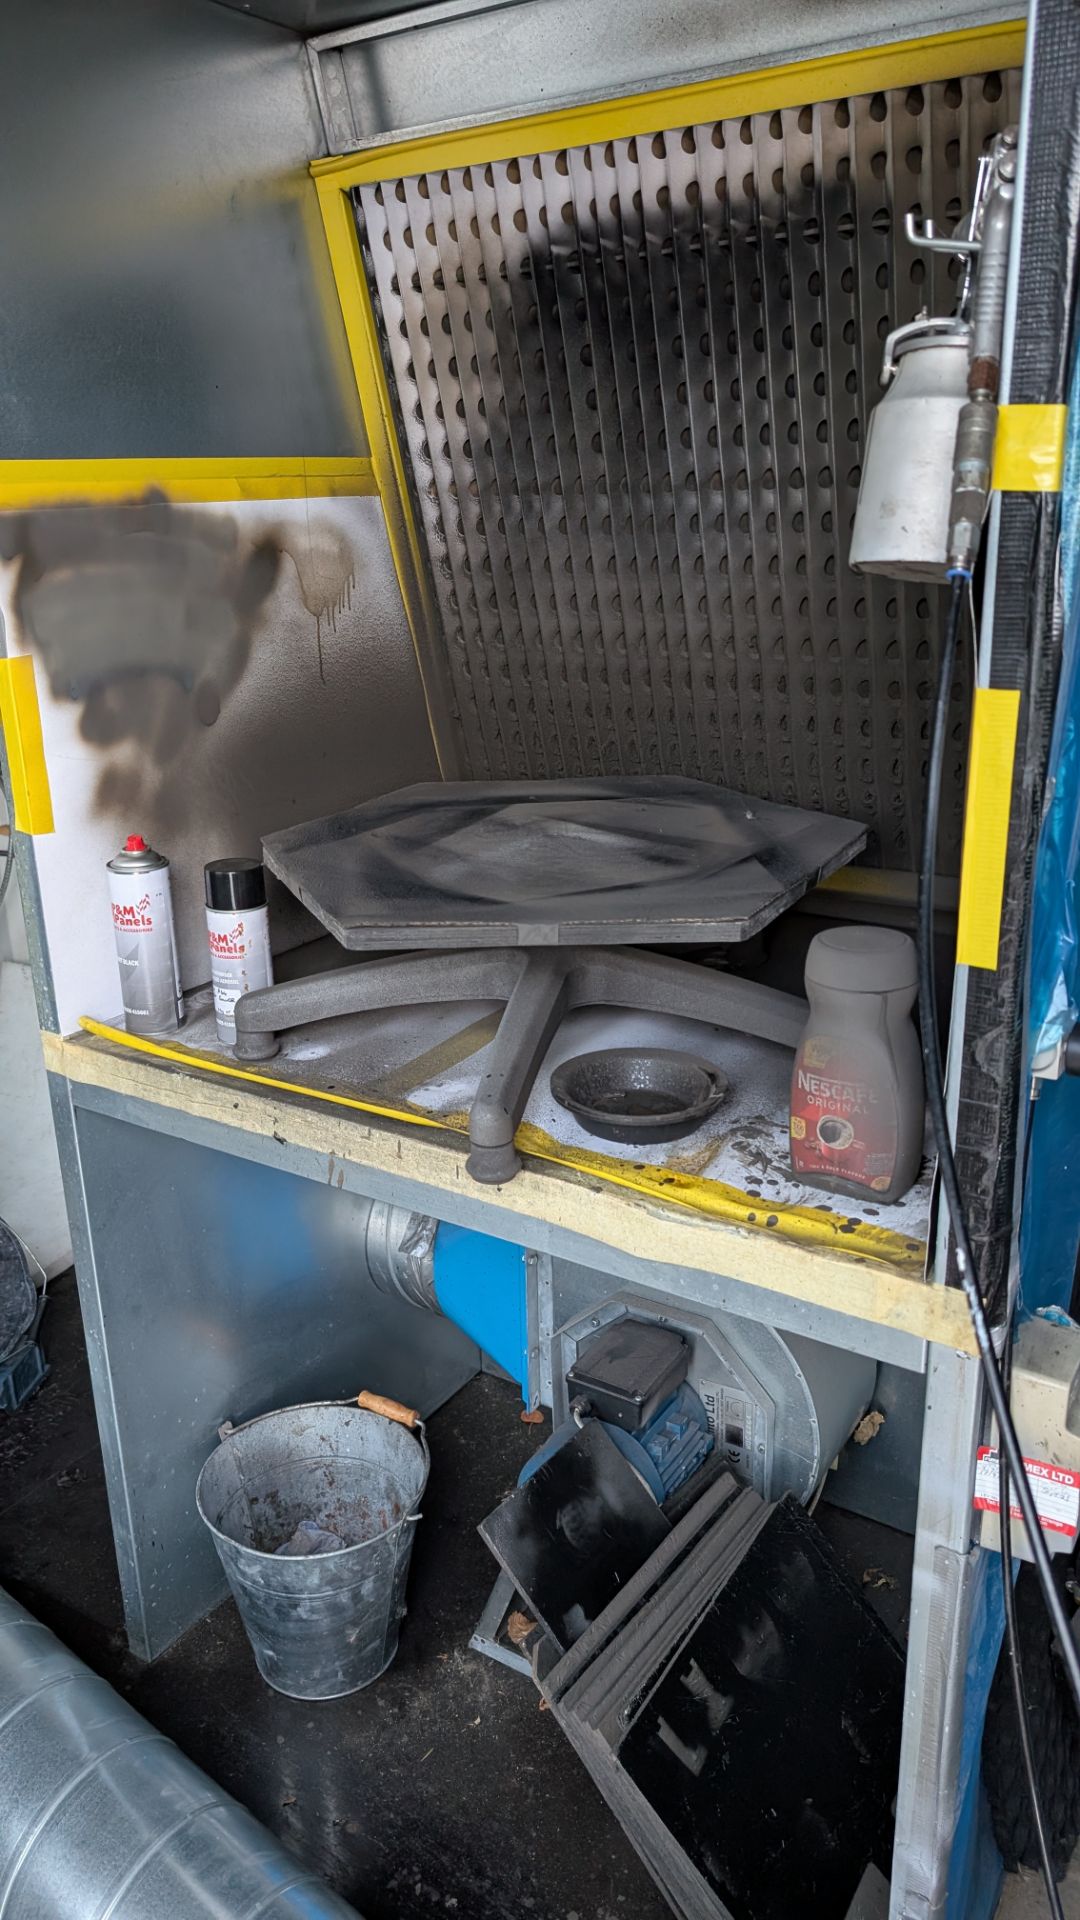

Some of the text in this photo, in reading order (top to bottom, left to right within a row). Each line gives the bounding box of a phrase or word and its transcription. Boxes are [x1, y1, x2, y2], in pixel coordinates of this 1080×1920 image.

[807, 1095, 869, 1114] ORIGINAL
[704, 1394, 715, 1413] Ltd
[1024, 1463, 1074, 1484] MEX LTD
